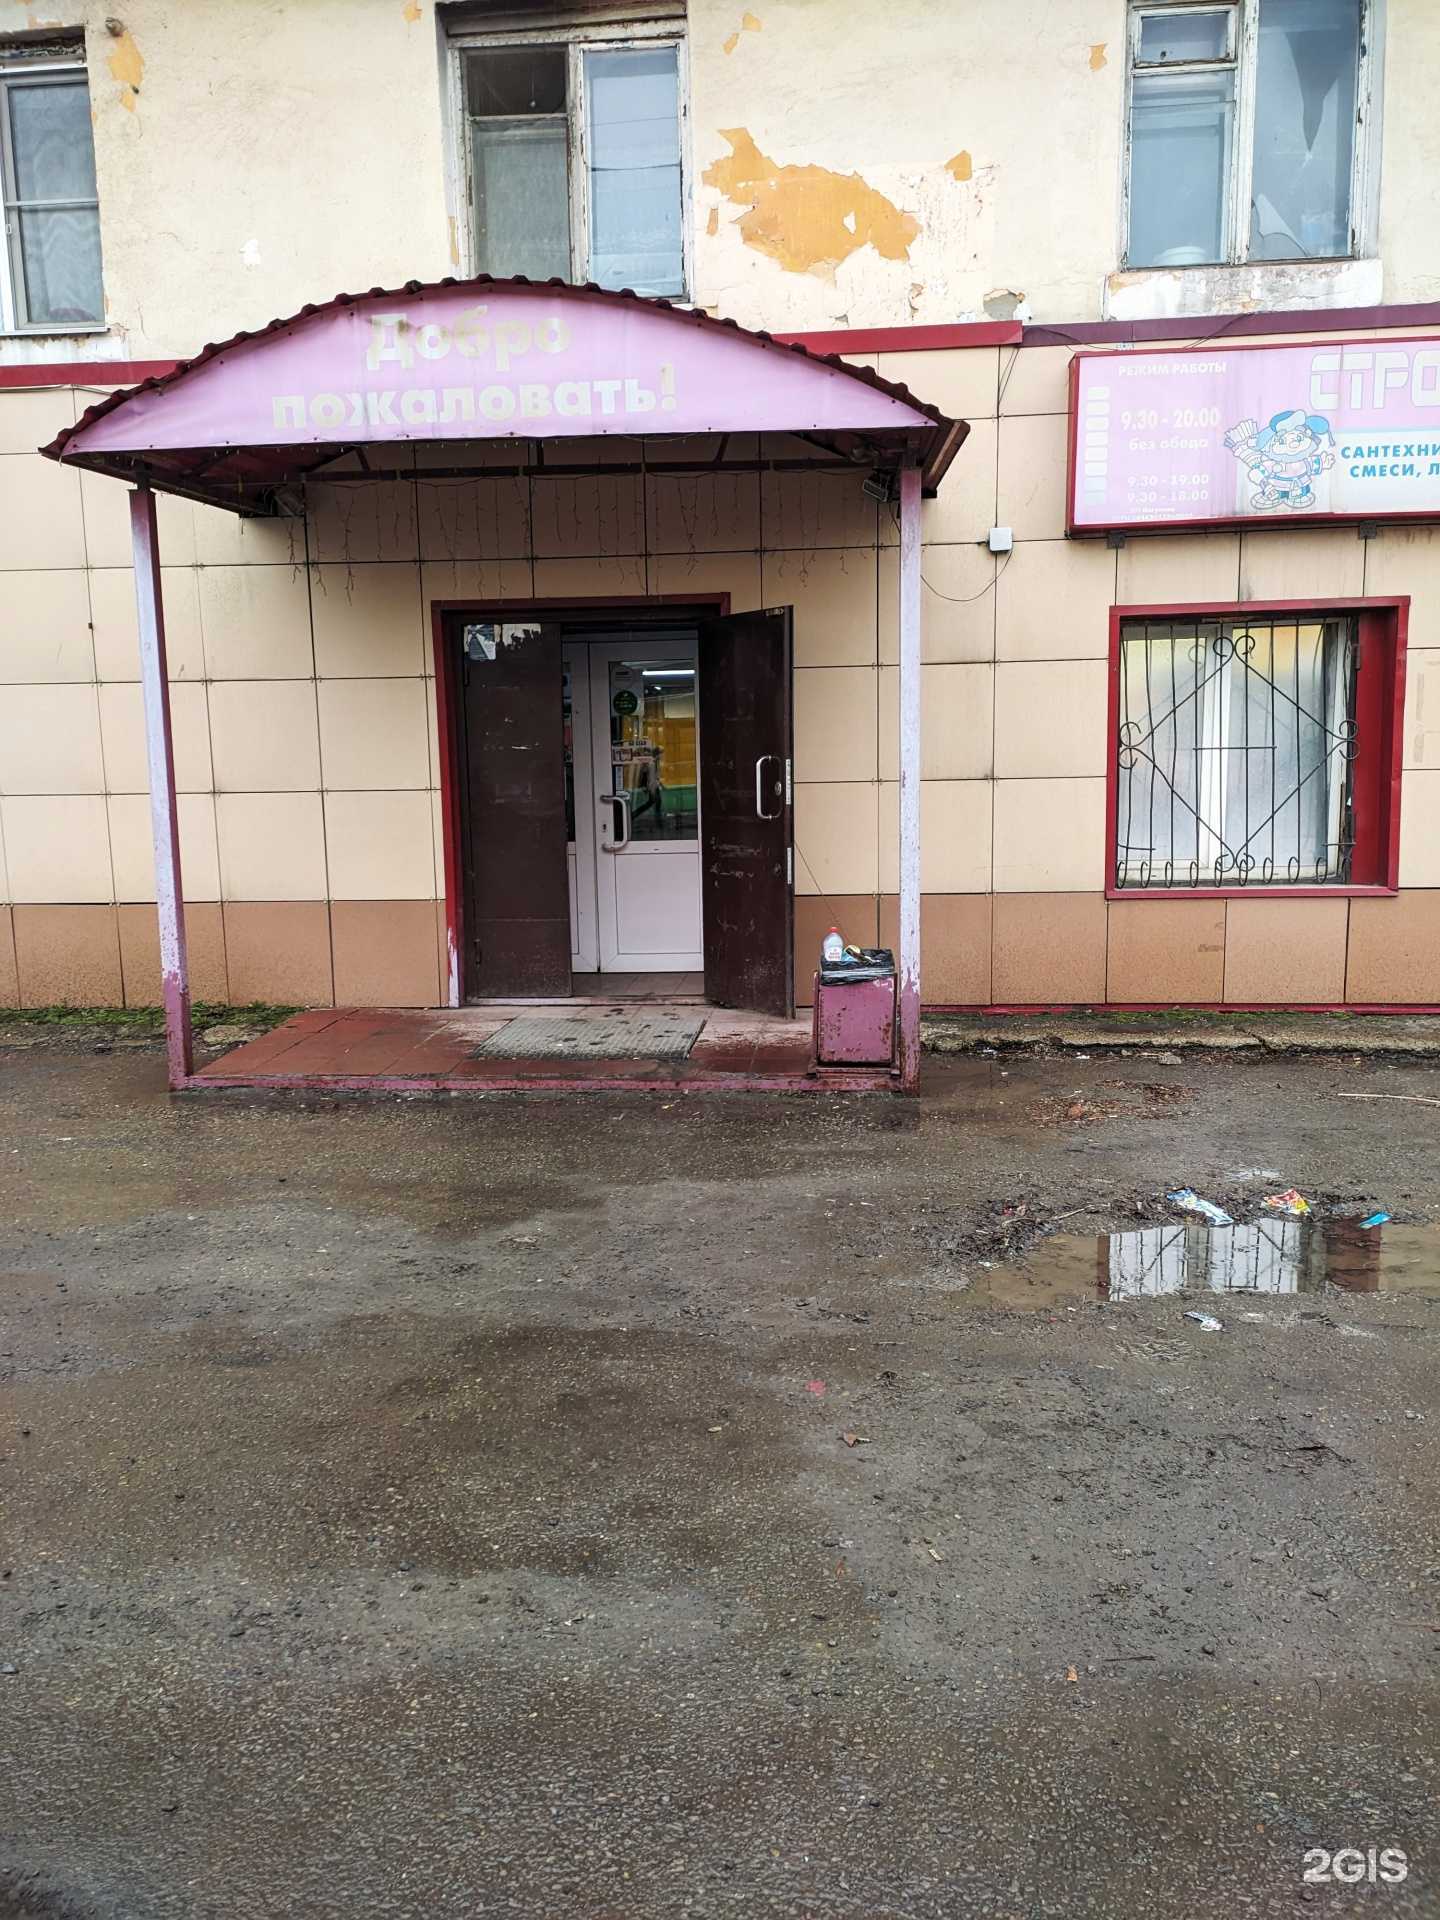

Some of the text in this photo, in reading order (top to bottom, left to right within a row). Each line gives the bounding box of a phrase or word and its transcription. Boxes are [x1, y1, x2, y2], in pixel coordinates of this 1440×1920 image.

[366, 304, 572, 371] Добро
[1118, 361, 1227, 377] РЕЖИМ РАБОТЫ
[1310, 349, 1440, 410] СТРО
[271, 362, 677, 430] пожаловать!
[1120, 409, 1158, 431] 9.30
[1173, 407, 1221, 428] 20.00
[1128, 435, 1209, 450] без обеда
[1349, 463, 1422, 478] СМЕСИ,
